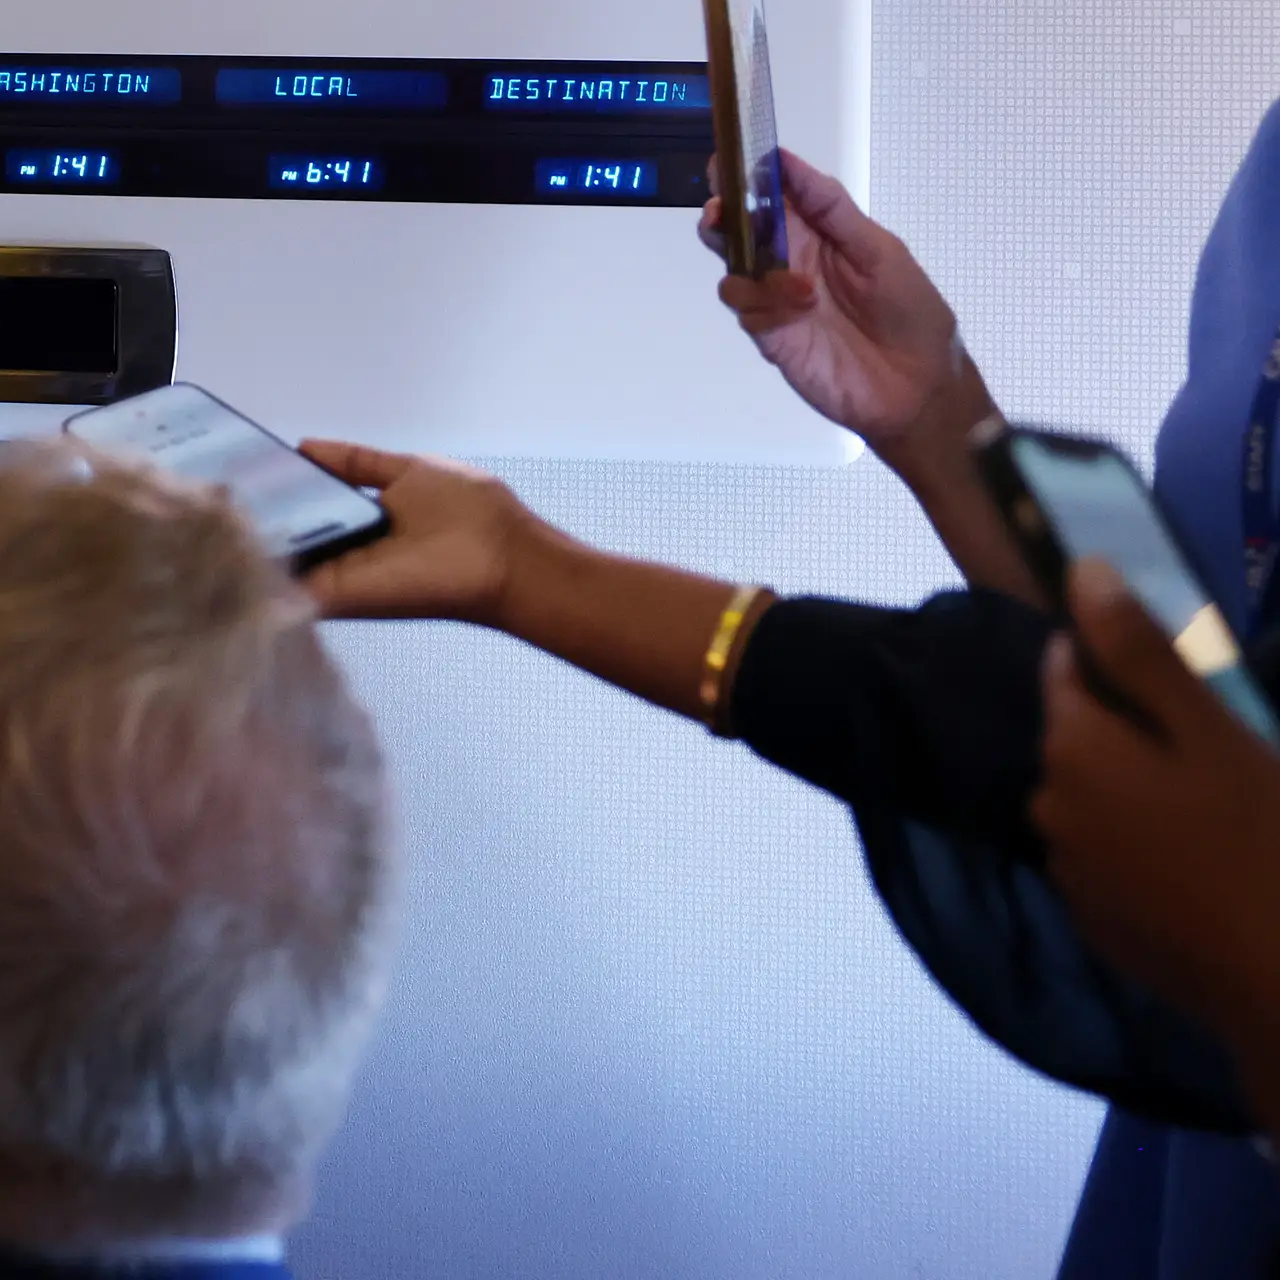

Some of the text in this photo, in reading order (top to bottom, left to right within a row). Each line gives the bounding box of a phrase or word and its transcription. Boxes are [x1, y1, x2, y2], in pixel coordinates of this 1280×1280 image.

[275, 76, 358, 96] LOCAL
[490, 78, 686, 102] DESTINATION
[20, 155, 106, 177] PM 1:41
[281, 161, 370, 183] PM 6:41
[550, 165, 641, 188] PM 1:41
